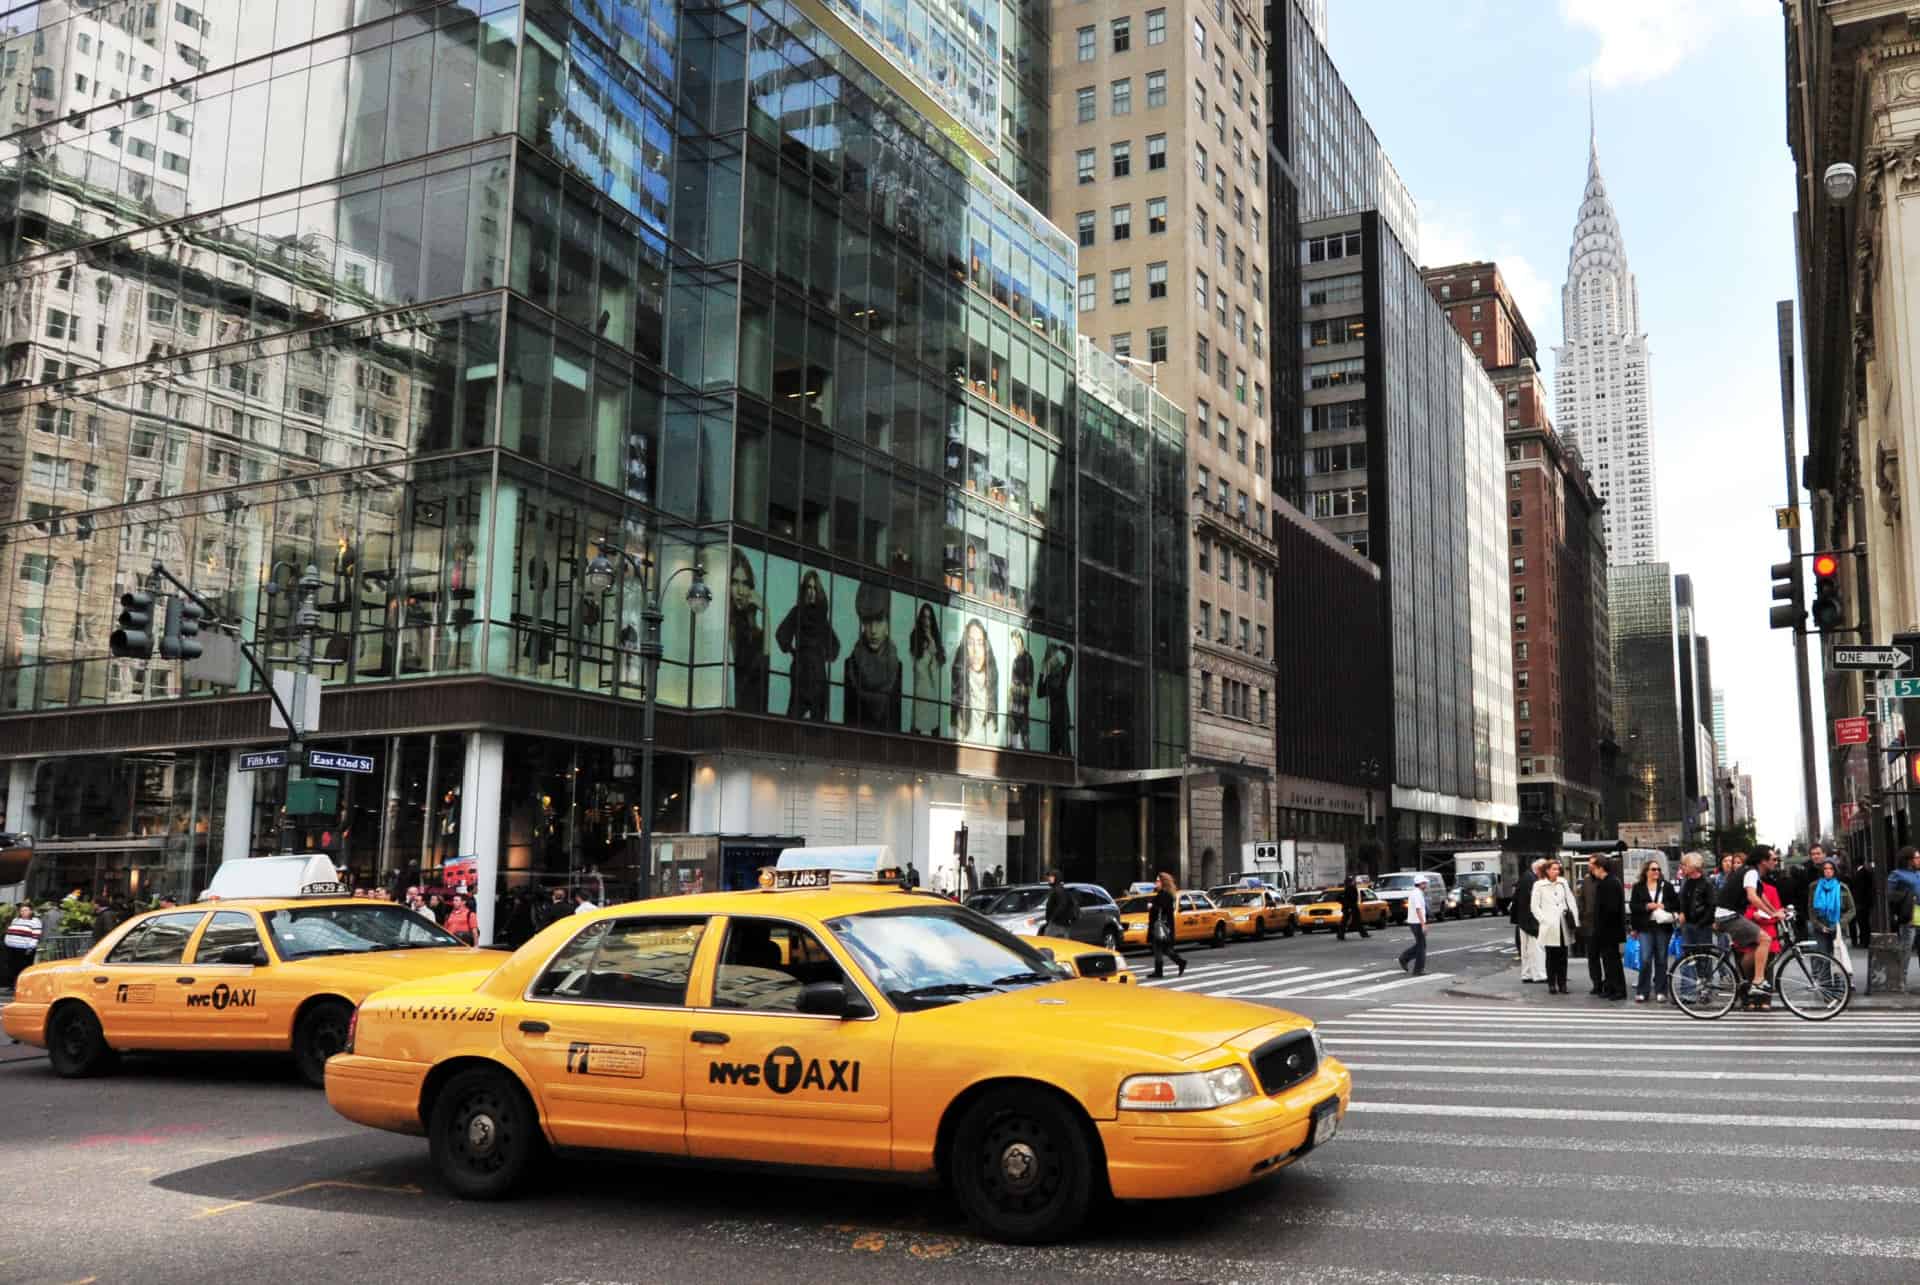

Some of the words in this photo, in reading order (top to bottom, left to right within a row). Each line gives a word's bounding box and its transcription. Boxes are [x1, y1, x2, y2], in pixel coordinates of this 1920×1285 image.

[1839, 652, 1863, 663] ONE
[1878, 653, 1901, 663] WAY
[1901, 680, 1912, 696] 5
[247, 756, 264, 766] Fifth
[265, 755, 280, 764] Ave
[312, 755, 334, 766] East
[337, 757, 359, 768] 42nd
[360, 760, 370, 770] St
[187, 994, 211, 1007] NYC
[212, 983, 256, 1010] TAXI
[709, 1061, 761, 1086] NYC
[764, 1046, 860, 1094] TAXI
